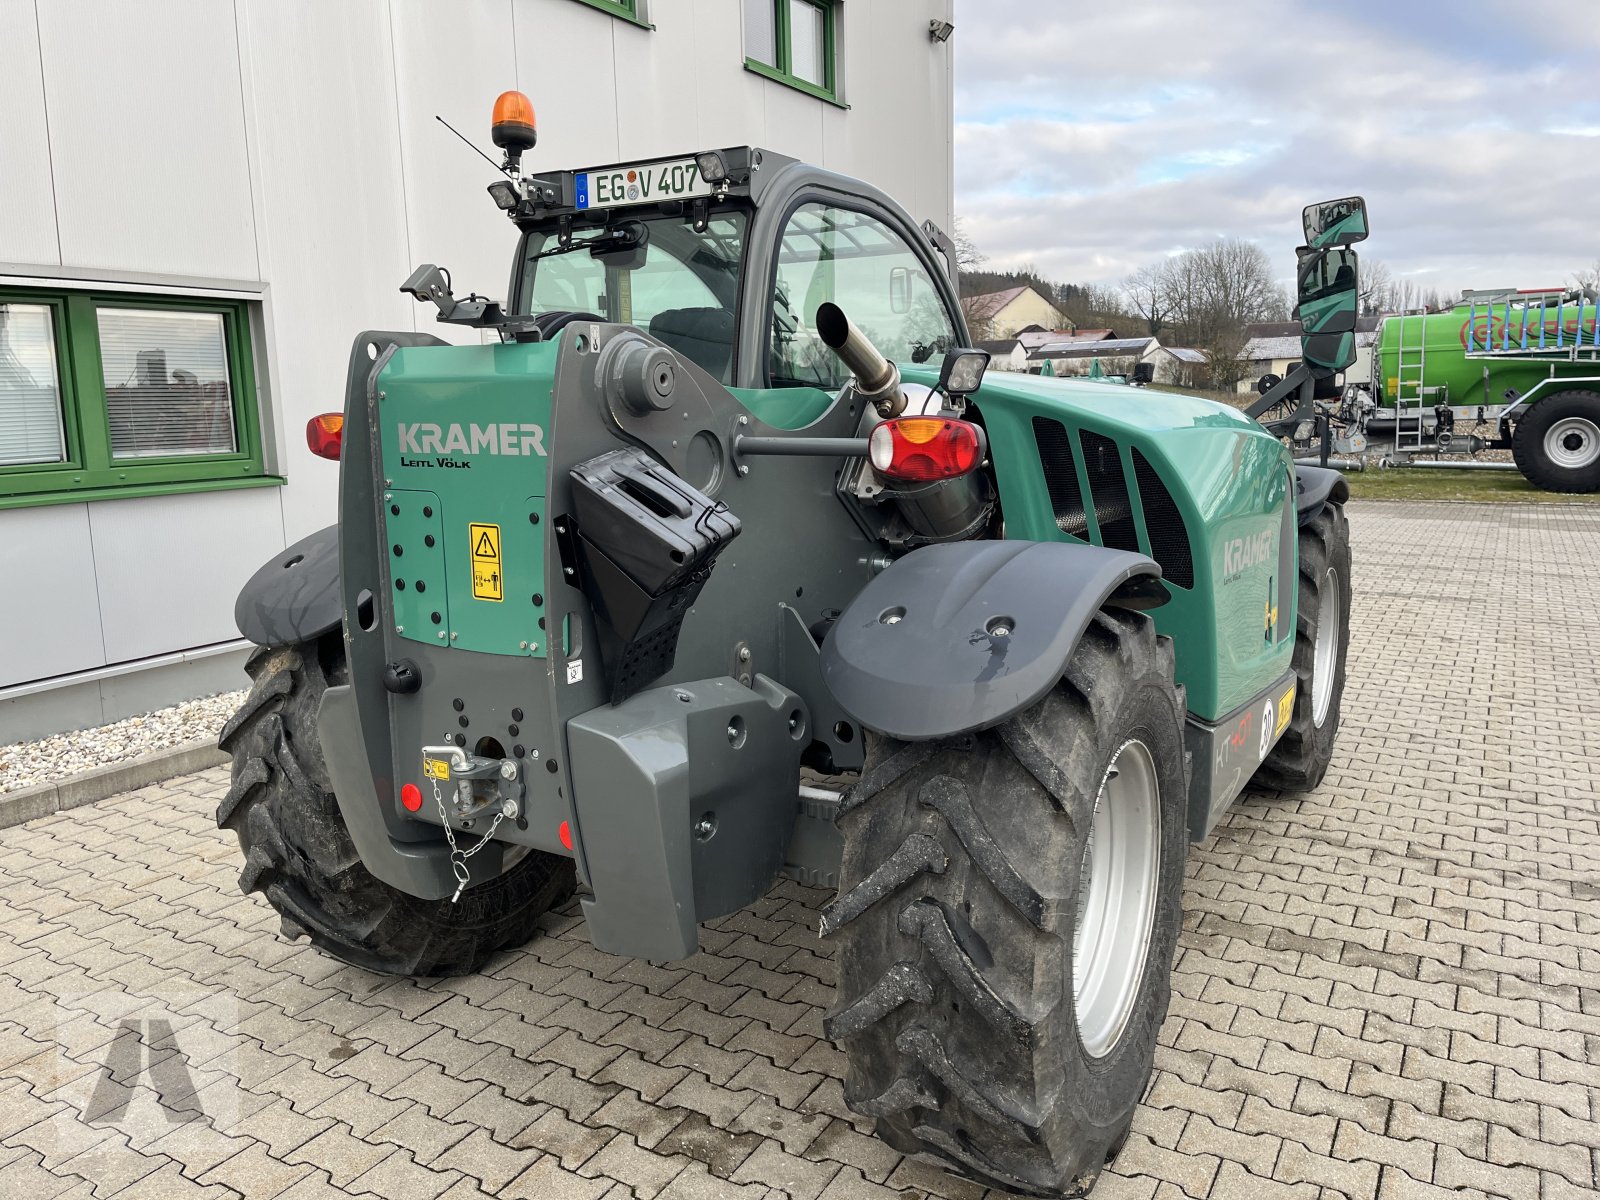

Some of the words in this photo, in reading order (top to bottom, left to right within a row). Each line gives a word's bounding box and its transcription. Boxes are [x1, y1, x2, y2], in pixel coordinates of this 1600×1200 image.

[579, 194, 585, 203] D
[596, 173, 625, 203] EG
[638, 169, 652, 197] V
[658, 163, 699, 194] 407
[398, 423, 548, 457] KRAMER
[1223, 530, 1272, 577] KRAMER
[1215, 734, 1231, 775] KT
[1231, 710, 1253, 752] 407
[1260, 708, 1272, 752] 30
